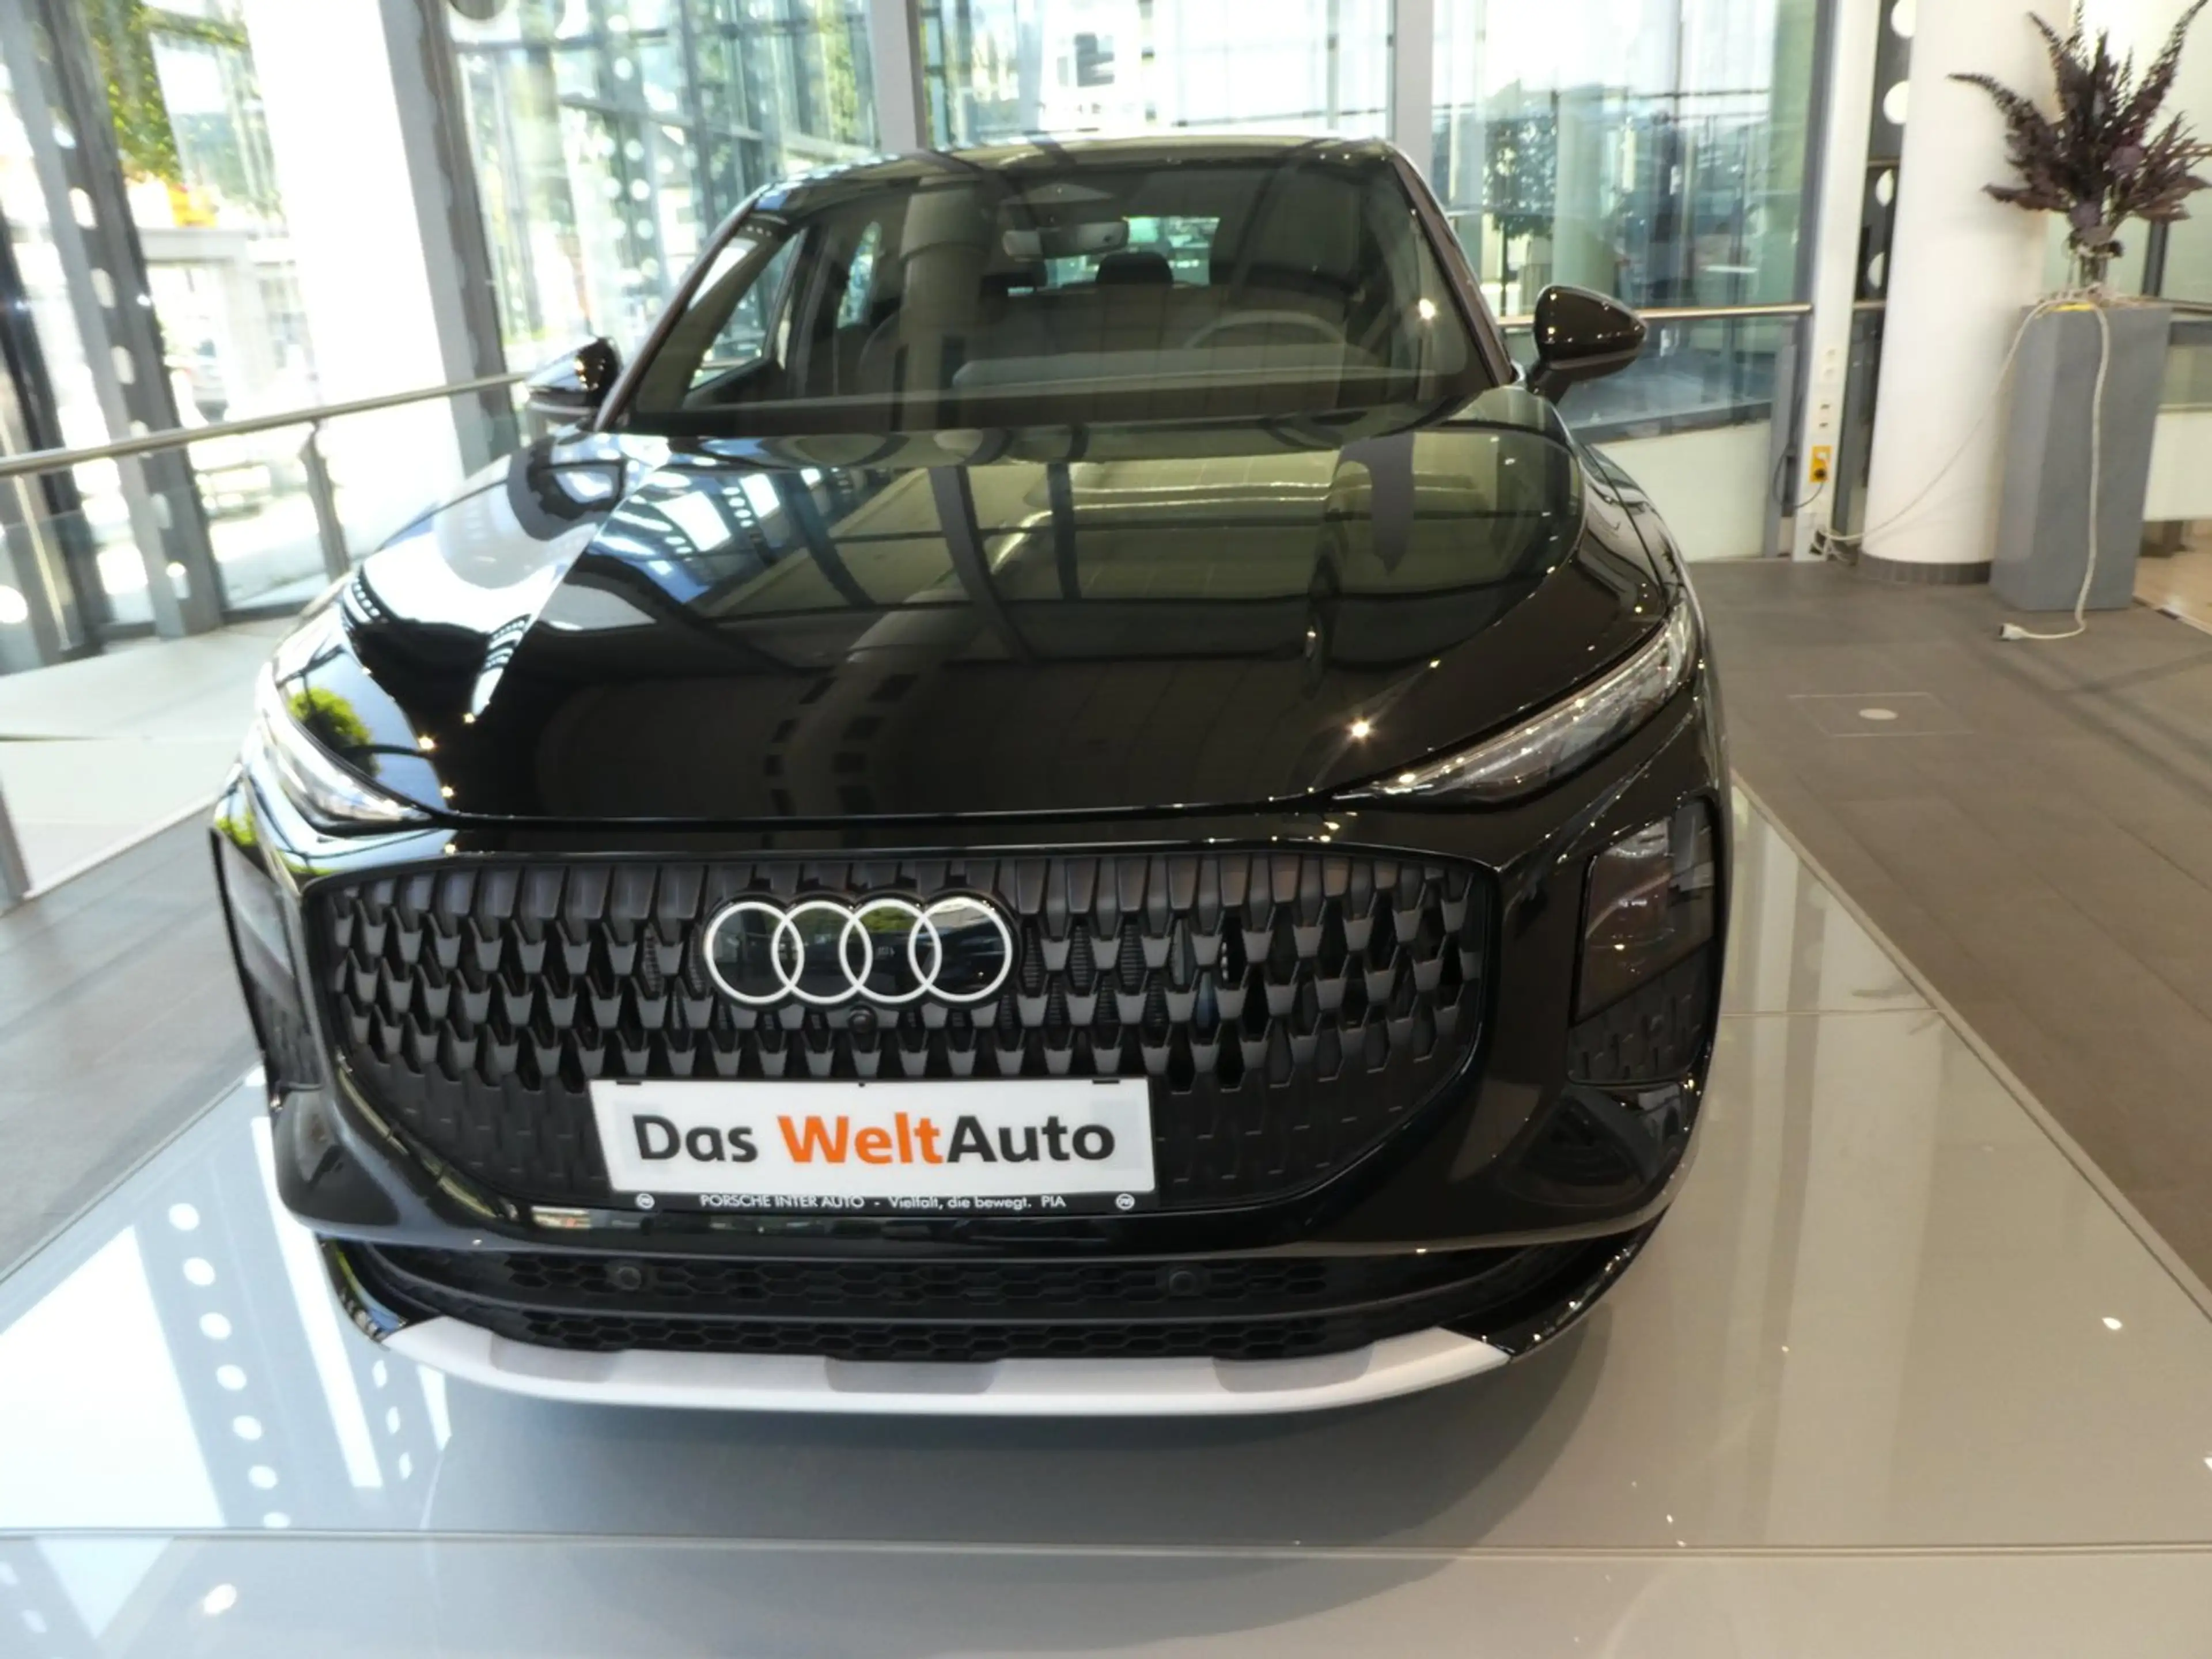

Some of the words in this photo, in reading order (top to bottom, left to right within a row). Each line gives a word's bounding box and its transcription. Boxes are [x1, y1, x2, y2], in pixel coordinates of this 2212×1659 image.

[632, 1113, 759, 1162] Das
[777, 1112, 1115, 1164] WeltAuto
[699, 1194, 771, 1208] PORSCHE
[777, 1194, 818, 1207] INTER
[820, 1195, 865, 1209] AUTO
[888, 1195, 944, 1210] Vielfalt,
[947, 1195, 971, 1208] die
[975, 1195, 1032, 1210] bewegt.
[1041, 1195, 1066, 1208] PIA
